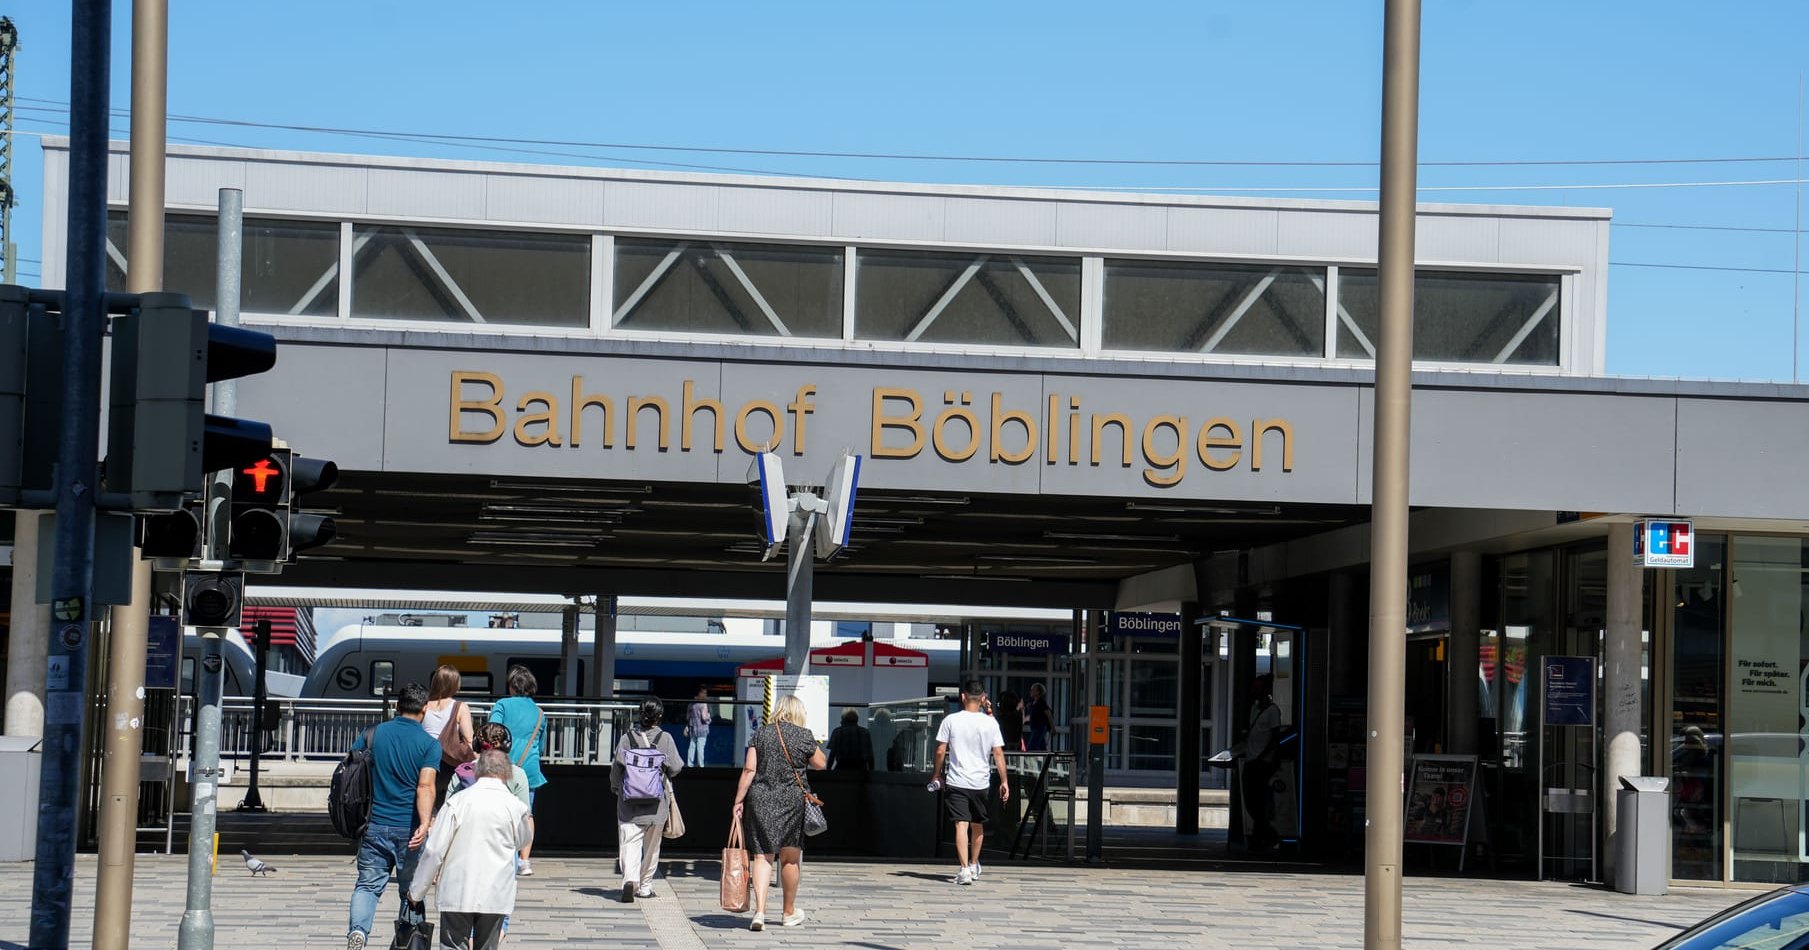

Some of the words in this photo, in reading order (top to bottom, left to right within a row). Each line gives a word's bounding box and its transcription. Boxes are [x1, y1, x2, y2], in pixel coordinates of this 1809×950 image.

[449, 370, 817, 456] Bahnhof
[870, 386, 1295, 488] Böblingen
[1649, 556, 1689, 564] Geldautomat
[1118, 616, 1181, 633] Böblingen
[996, 635, 1050, 650] Böblingen
[1753, 660, 1779, 668] sofort.
[1749, 669, 1762, 677] Für
[1764, 669, 1791, 679] später.
[1742, 678, 1754, 686] Für
[1756, 679, 1777, 687] mich.
